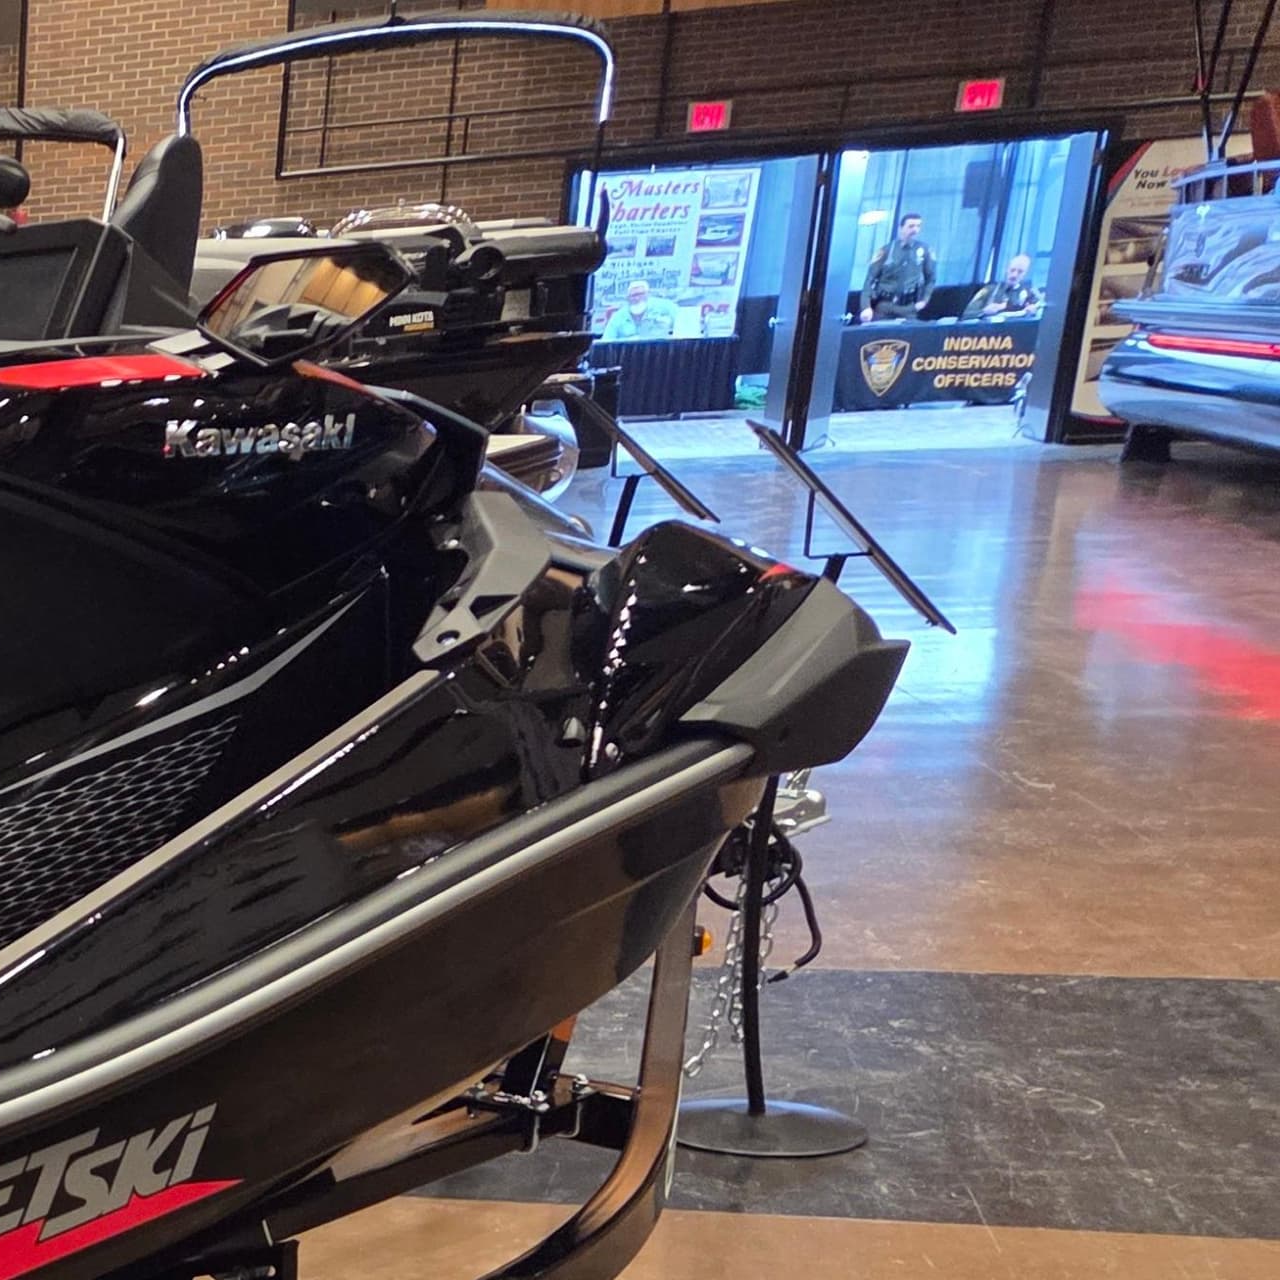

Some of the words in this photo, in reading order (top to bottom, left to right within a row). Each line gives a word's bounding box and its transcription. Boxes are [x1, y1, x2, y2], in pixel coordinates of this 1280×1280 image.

[1134, 168, 1159, 180] You
[610, 179, 701, 200] Masters
[610, 201, 692, 223] harters
[943, 335, 1014, 351] INDIANA
[932, 372, 1017, 389] OFFICERS
[162, 412, 357, 461] Kawasaki
